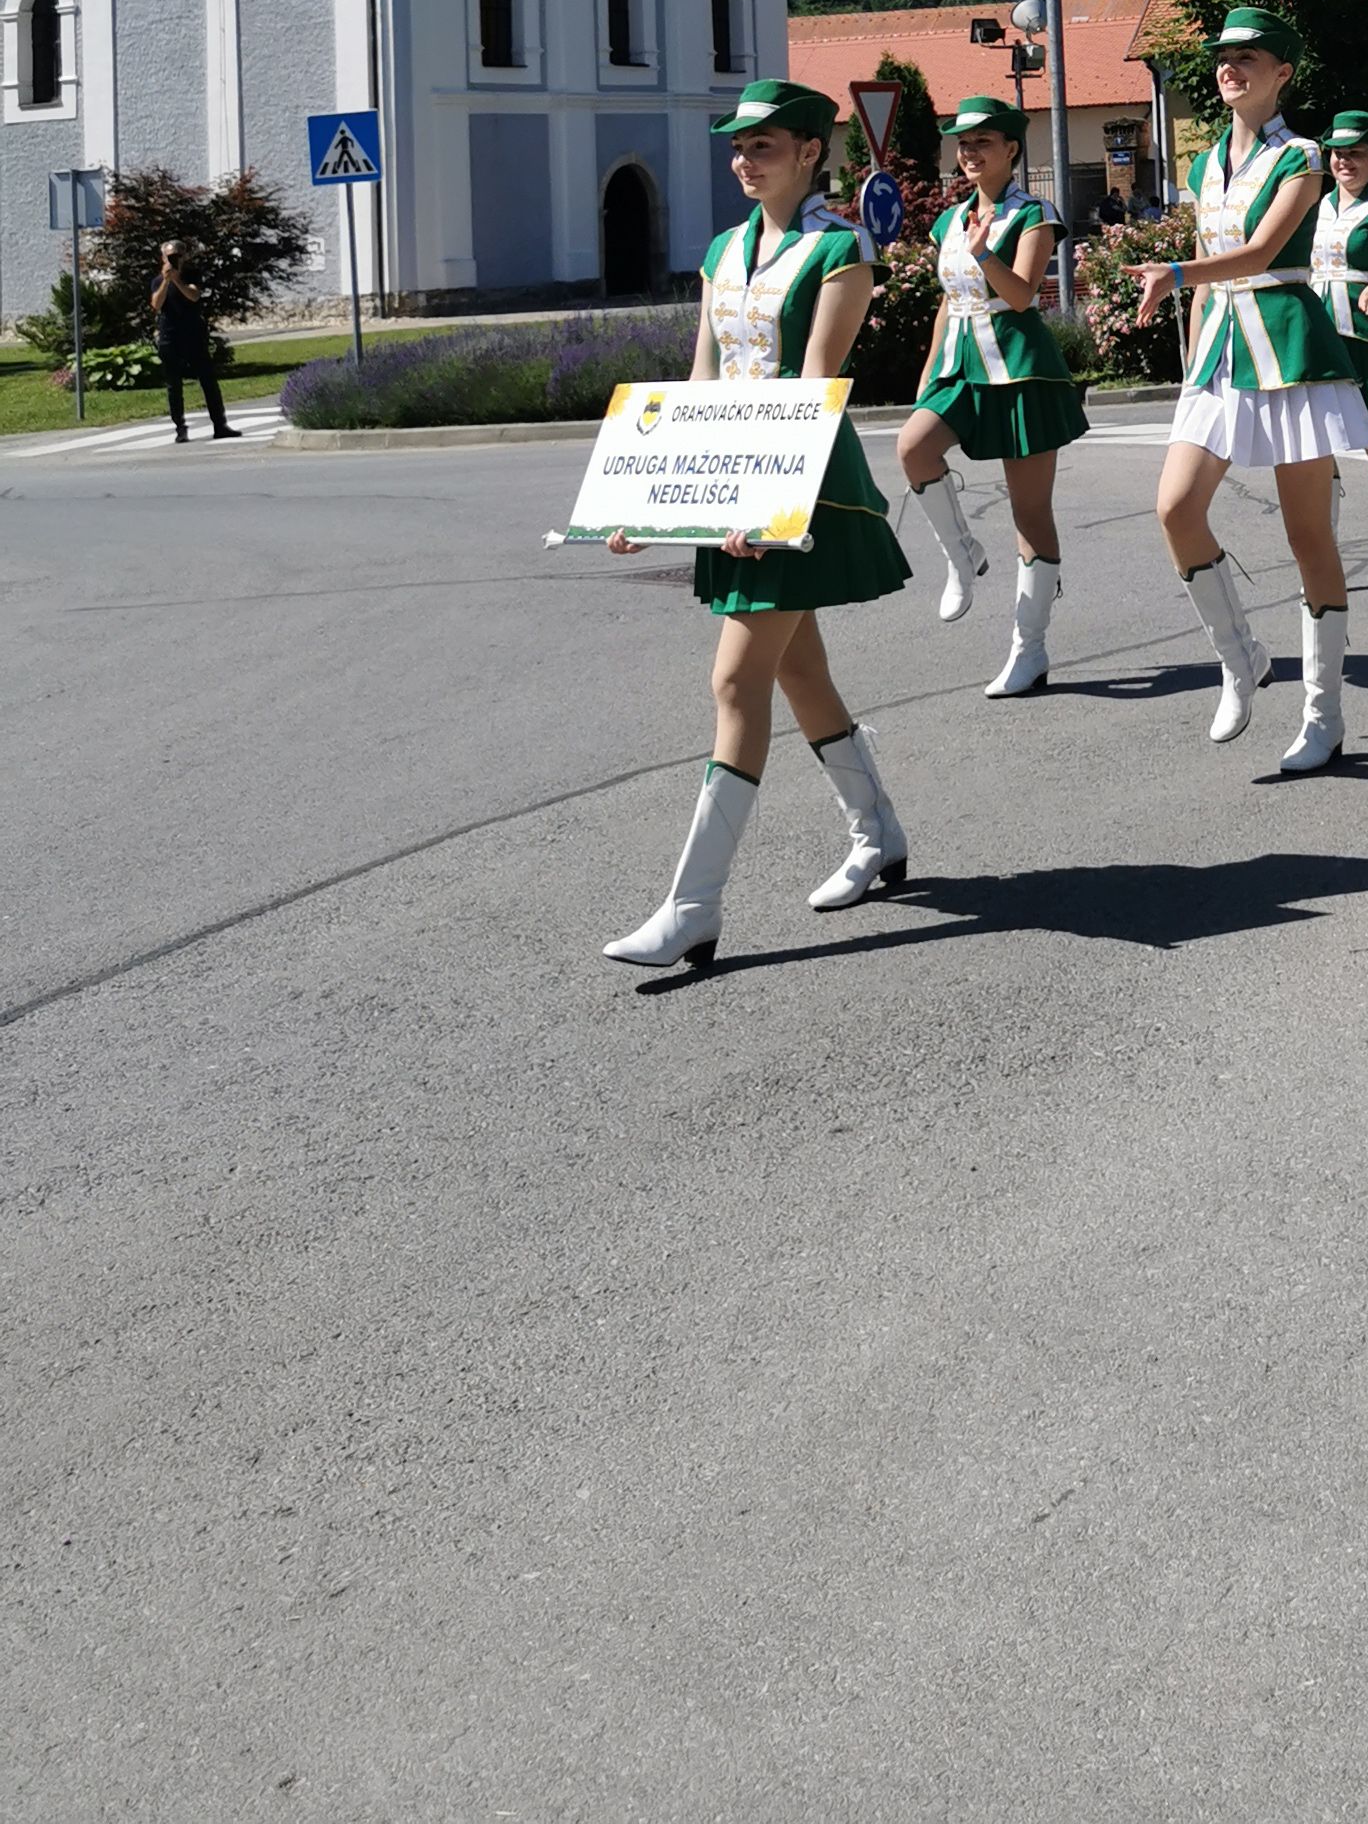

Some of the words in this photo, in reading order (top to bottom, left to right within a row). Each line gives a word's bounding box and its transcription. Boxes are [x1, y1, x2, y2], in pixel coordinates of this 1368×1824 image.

[672, 400, 753, 422] ORAHOVAČKO
[603, 455, 668, 475] UDRUGA
[672, 449, 806, 475] MAŽORETKINJA
[647, 479, 740, 504] NEDELIŠĆA
